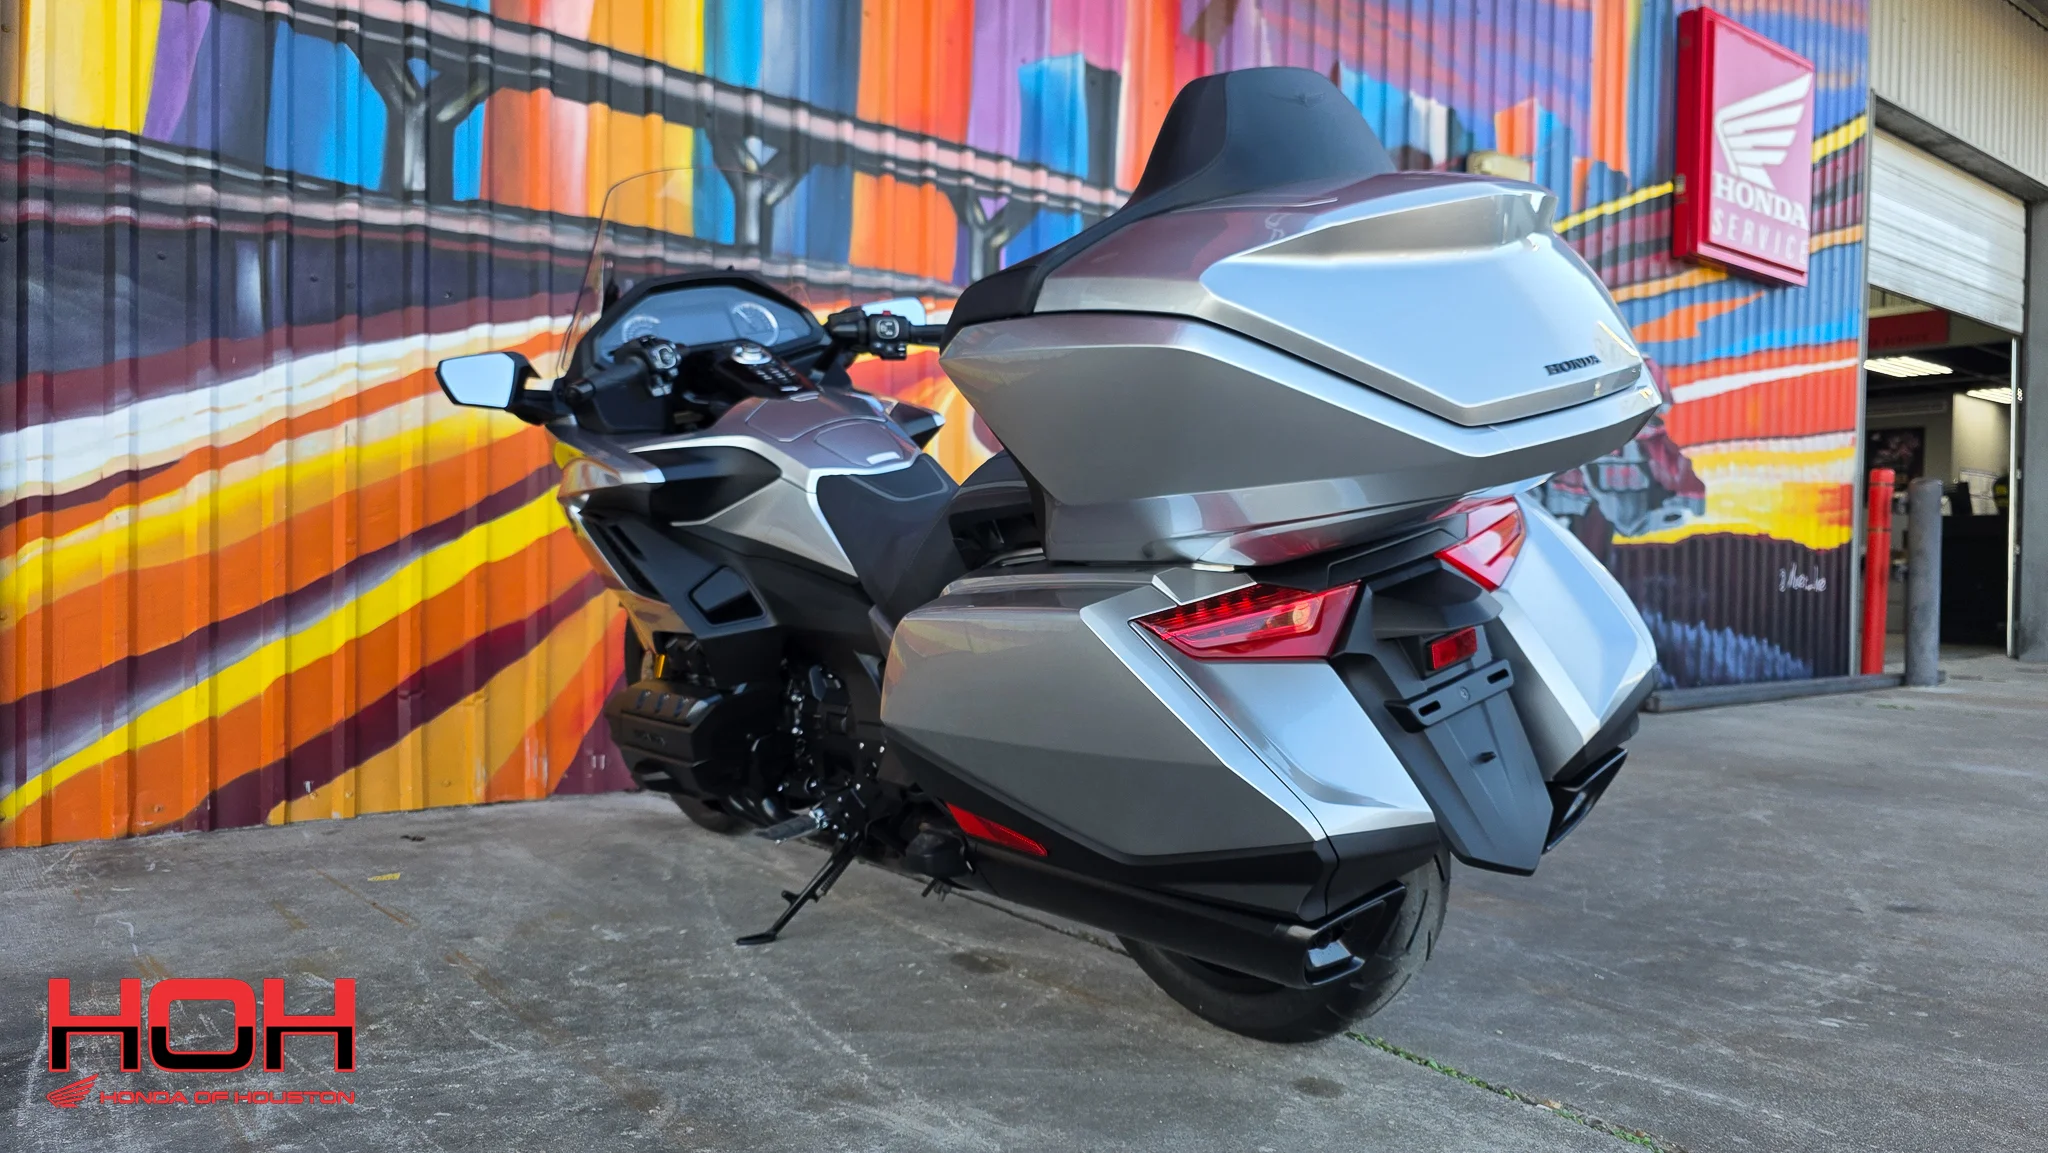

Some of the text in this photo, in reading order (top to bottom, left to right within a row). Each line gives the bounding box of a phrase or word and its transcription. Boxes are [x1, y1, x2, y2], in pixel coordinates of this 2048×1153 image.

[1713, 170, 1809, 232] HONDA
[1712, 207, 1808, 265] SERVICE
[1543, 354, 1602, 376] HONDA
